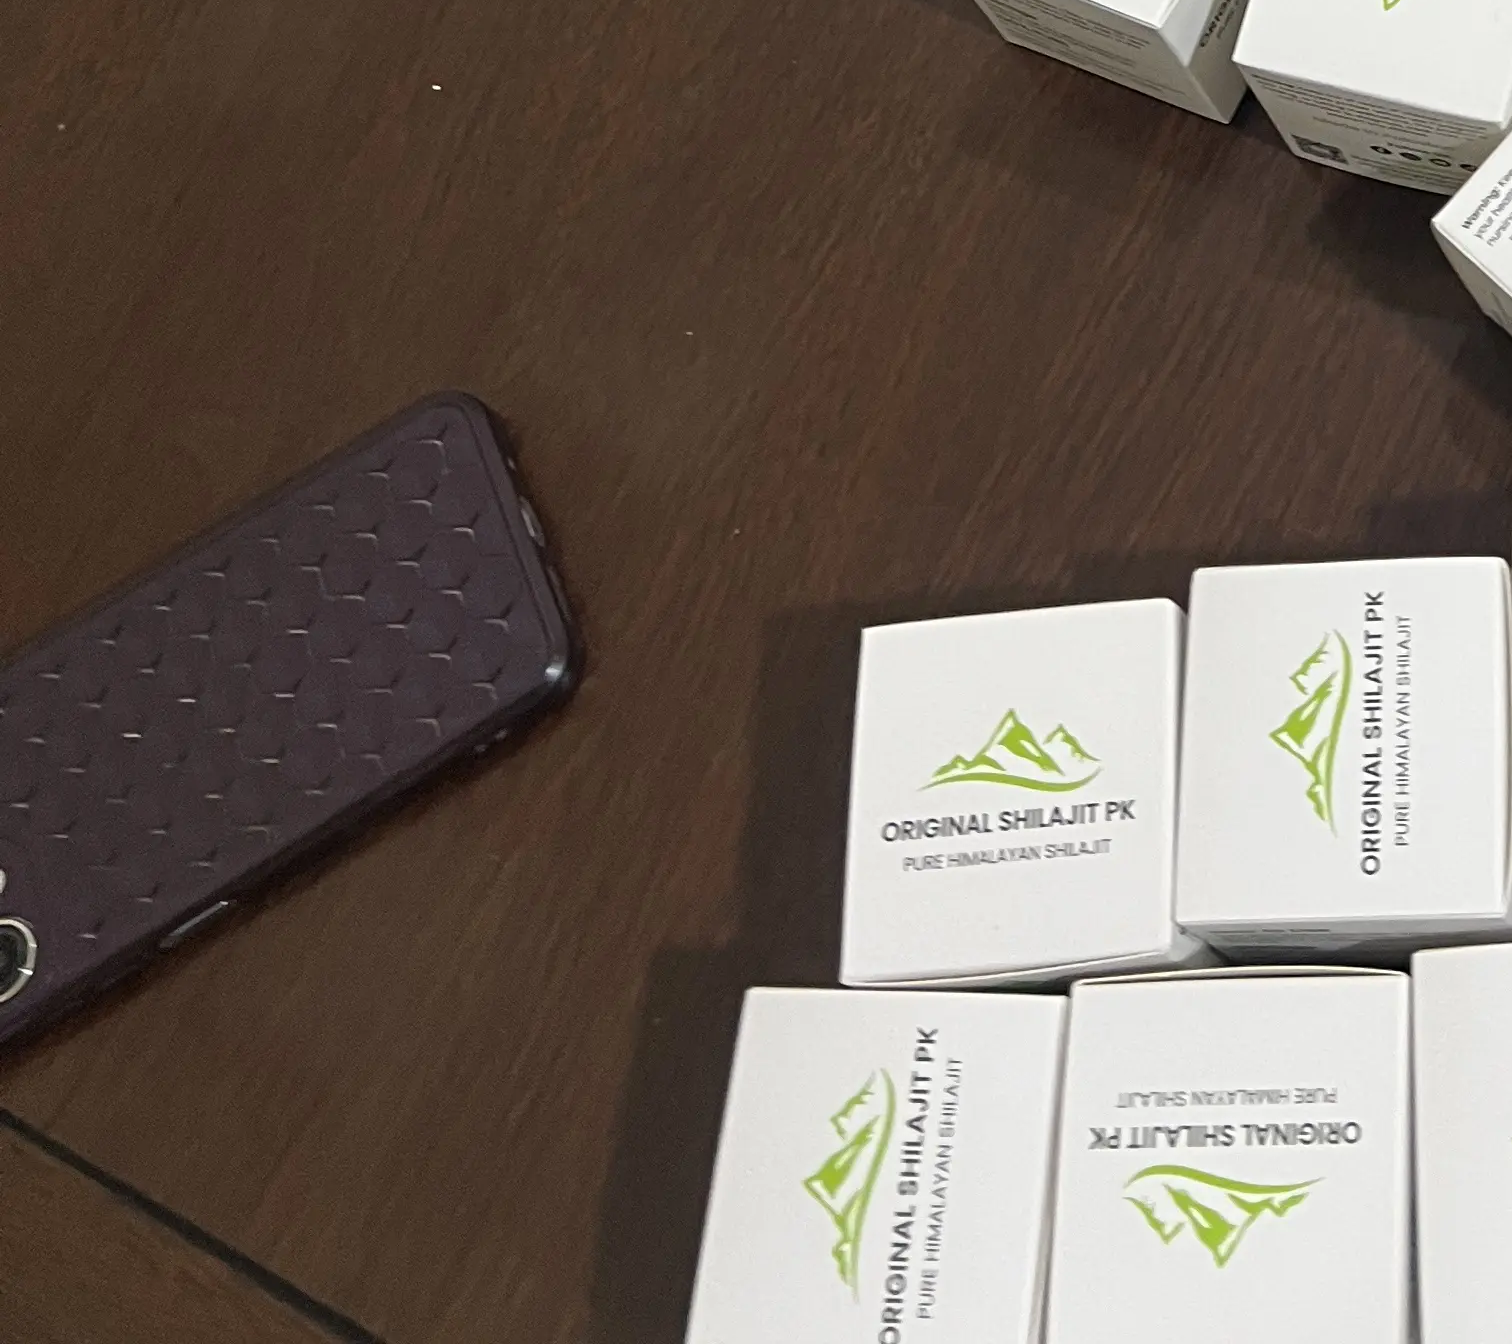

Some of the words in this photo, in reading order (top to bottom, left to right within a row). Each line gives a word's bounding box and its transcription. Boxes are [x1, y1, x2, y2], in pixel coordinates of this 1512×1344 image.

[1365, 592, 1383, 621] PK
[1396, 616, 1410, 685] SHILAJIT
[1363, 630, 1382, 738] SHILAJIT
[1395, 692, 1409, 794] HIMALAYAN
[881, 813, 993, 841] ORIGINAL
[998, 803, 1099, 830] SHILAJIT
[1105, 799, 1135, 820] PK
[1360, 747, 1381, 874] ORIGINAL
[1394, 806, 1409, 845] PURE
[914, 1028, 937, 1061] PK
[898, 1071, 931, 1195] SHILAJIT
[1088, 1127, 1120, 1149] PK
[1126, 1124, 1234, 1148] SHILAJIT
[1240, 1122, 1361, 1145] ORIGINAL
